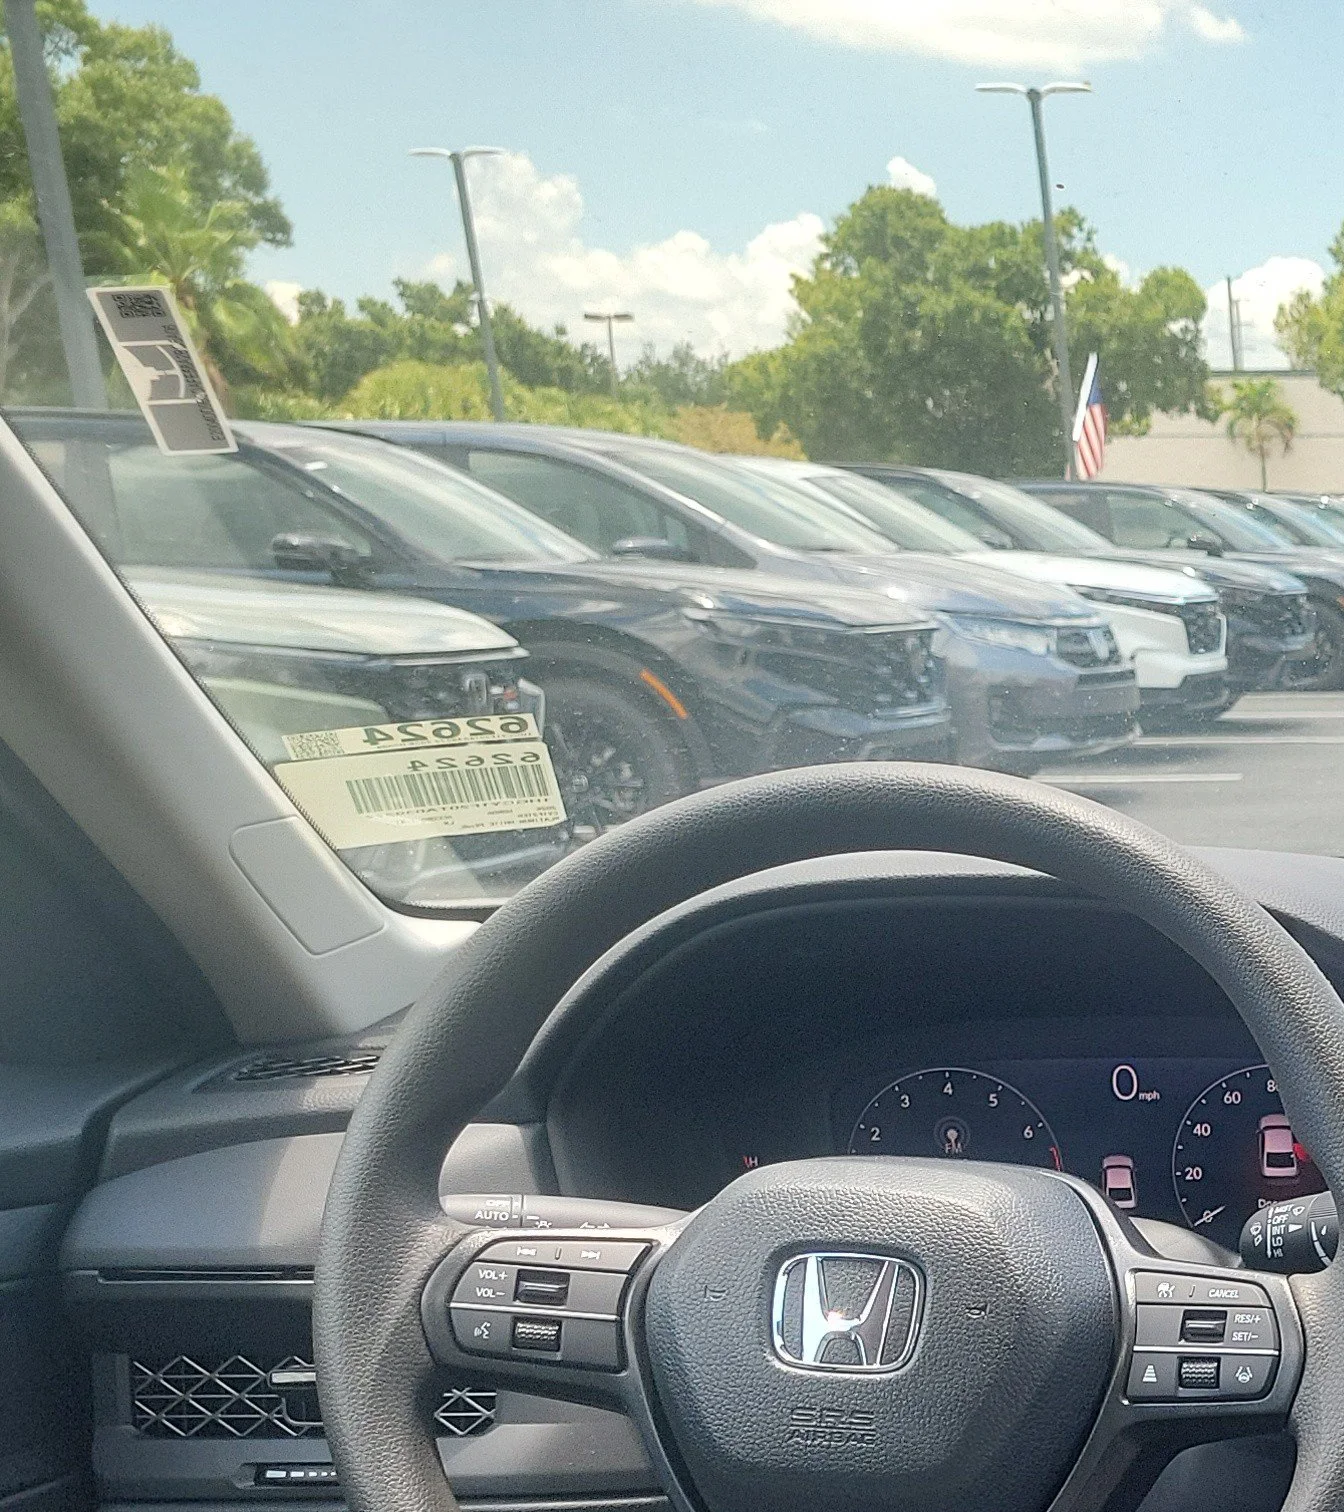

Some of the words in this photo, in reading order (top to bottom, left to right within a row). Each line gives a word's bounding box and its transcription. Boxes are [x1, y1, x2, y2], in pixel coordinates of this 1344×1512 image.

[943, 1082, 953, 1096] 4
[1112, 1064, 1138, 1100] 0
[1139, 1090, 1160, 1101] mph
[900, 1094, 910, 1108] 3
[988, 1093, 998, 1107] 5
[1223, 1091, 1241, 1105] 60
[870, 1127, 881, 1141] 2
[1023, 1125, 1033, 1139] 6
[1193, 1123, 1211, 1137] 40
[1185, 1167, 1202, 1180] 20
[475, 1211, 509, 1221] AUTO
[1272, 1215, 1288, 1225] OFF
[1272, 1226, 1286, 1236] INT
[1272, 1237, 1284, 1247] LO
[1208, 1288, 1239, 1298] CANCEL
[1234, 1313, 1261, 1324] RES/+
[1232, 1331, 1258, 1342] SET/-
